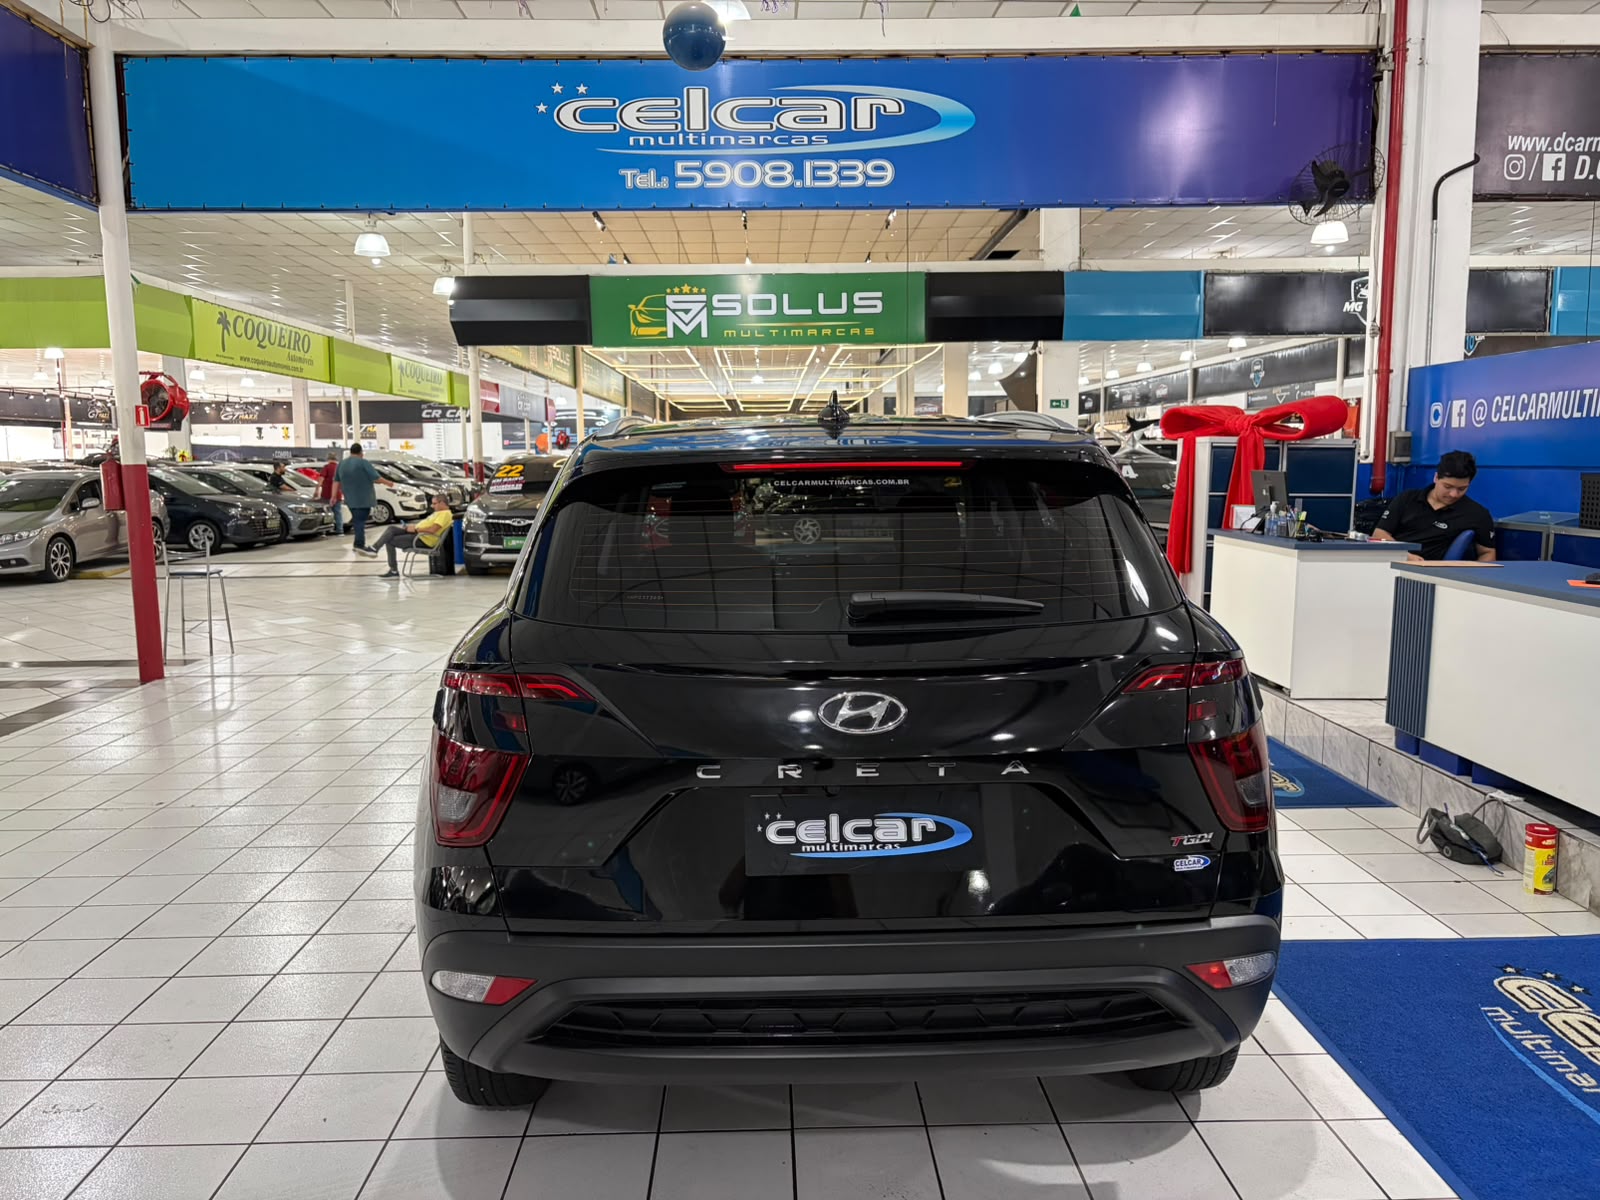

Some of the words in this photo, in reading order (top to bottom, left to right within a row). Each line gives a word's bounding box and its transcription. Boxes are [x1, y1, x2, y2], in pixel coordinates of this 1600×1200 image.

[554, 86, 906, 134] celcar
[628, 133, 829, 147] multimarcas
[619, 168, 669, 190] Tel.:
[674, 159, 896, 190] 5908.1339
[712, 291, 883, 316] SOLUS
[1343, 301, 1364, 312] MG
[232, 314, 311, 354] COQUEIRO
[723, 327, 875, 338] MULTIMARCAS
[1490, 387, 1600, 423] CELCARMULTI
[421, 409, 443, 418] CR
[494, 464, 525, 478] 22
[773, 478, 910, 487] CELCARMULTIMARCAS.COM.BR
[696, 760, 1030, 780] CRETA
[765, 813, 937, 845] celcar
[801, 842, 901, 853] multimarcas
[1175, 858, 1203, 867] CELCAR
